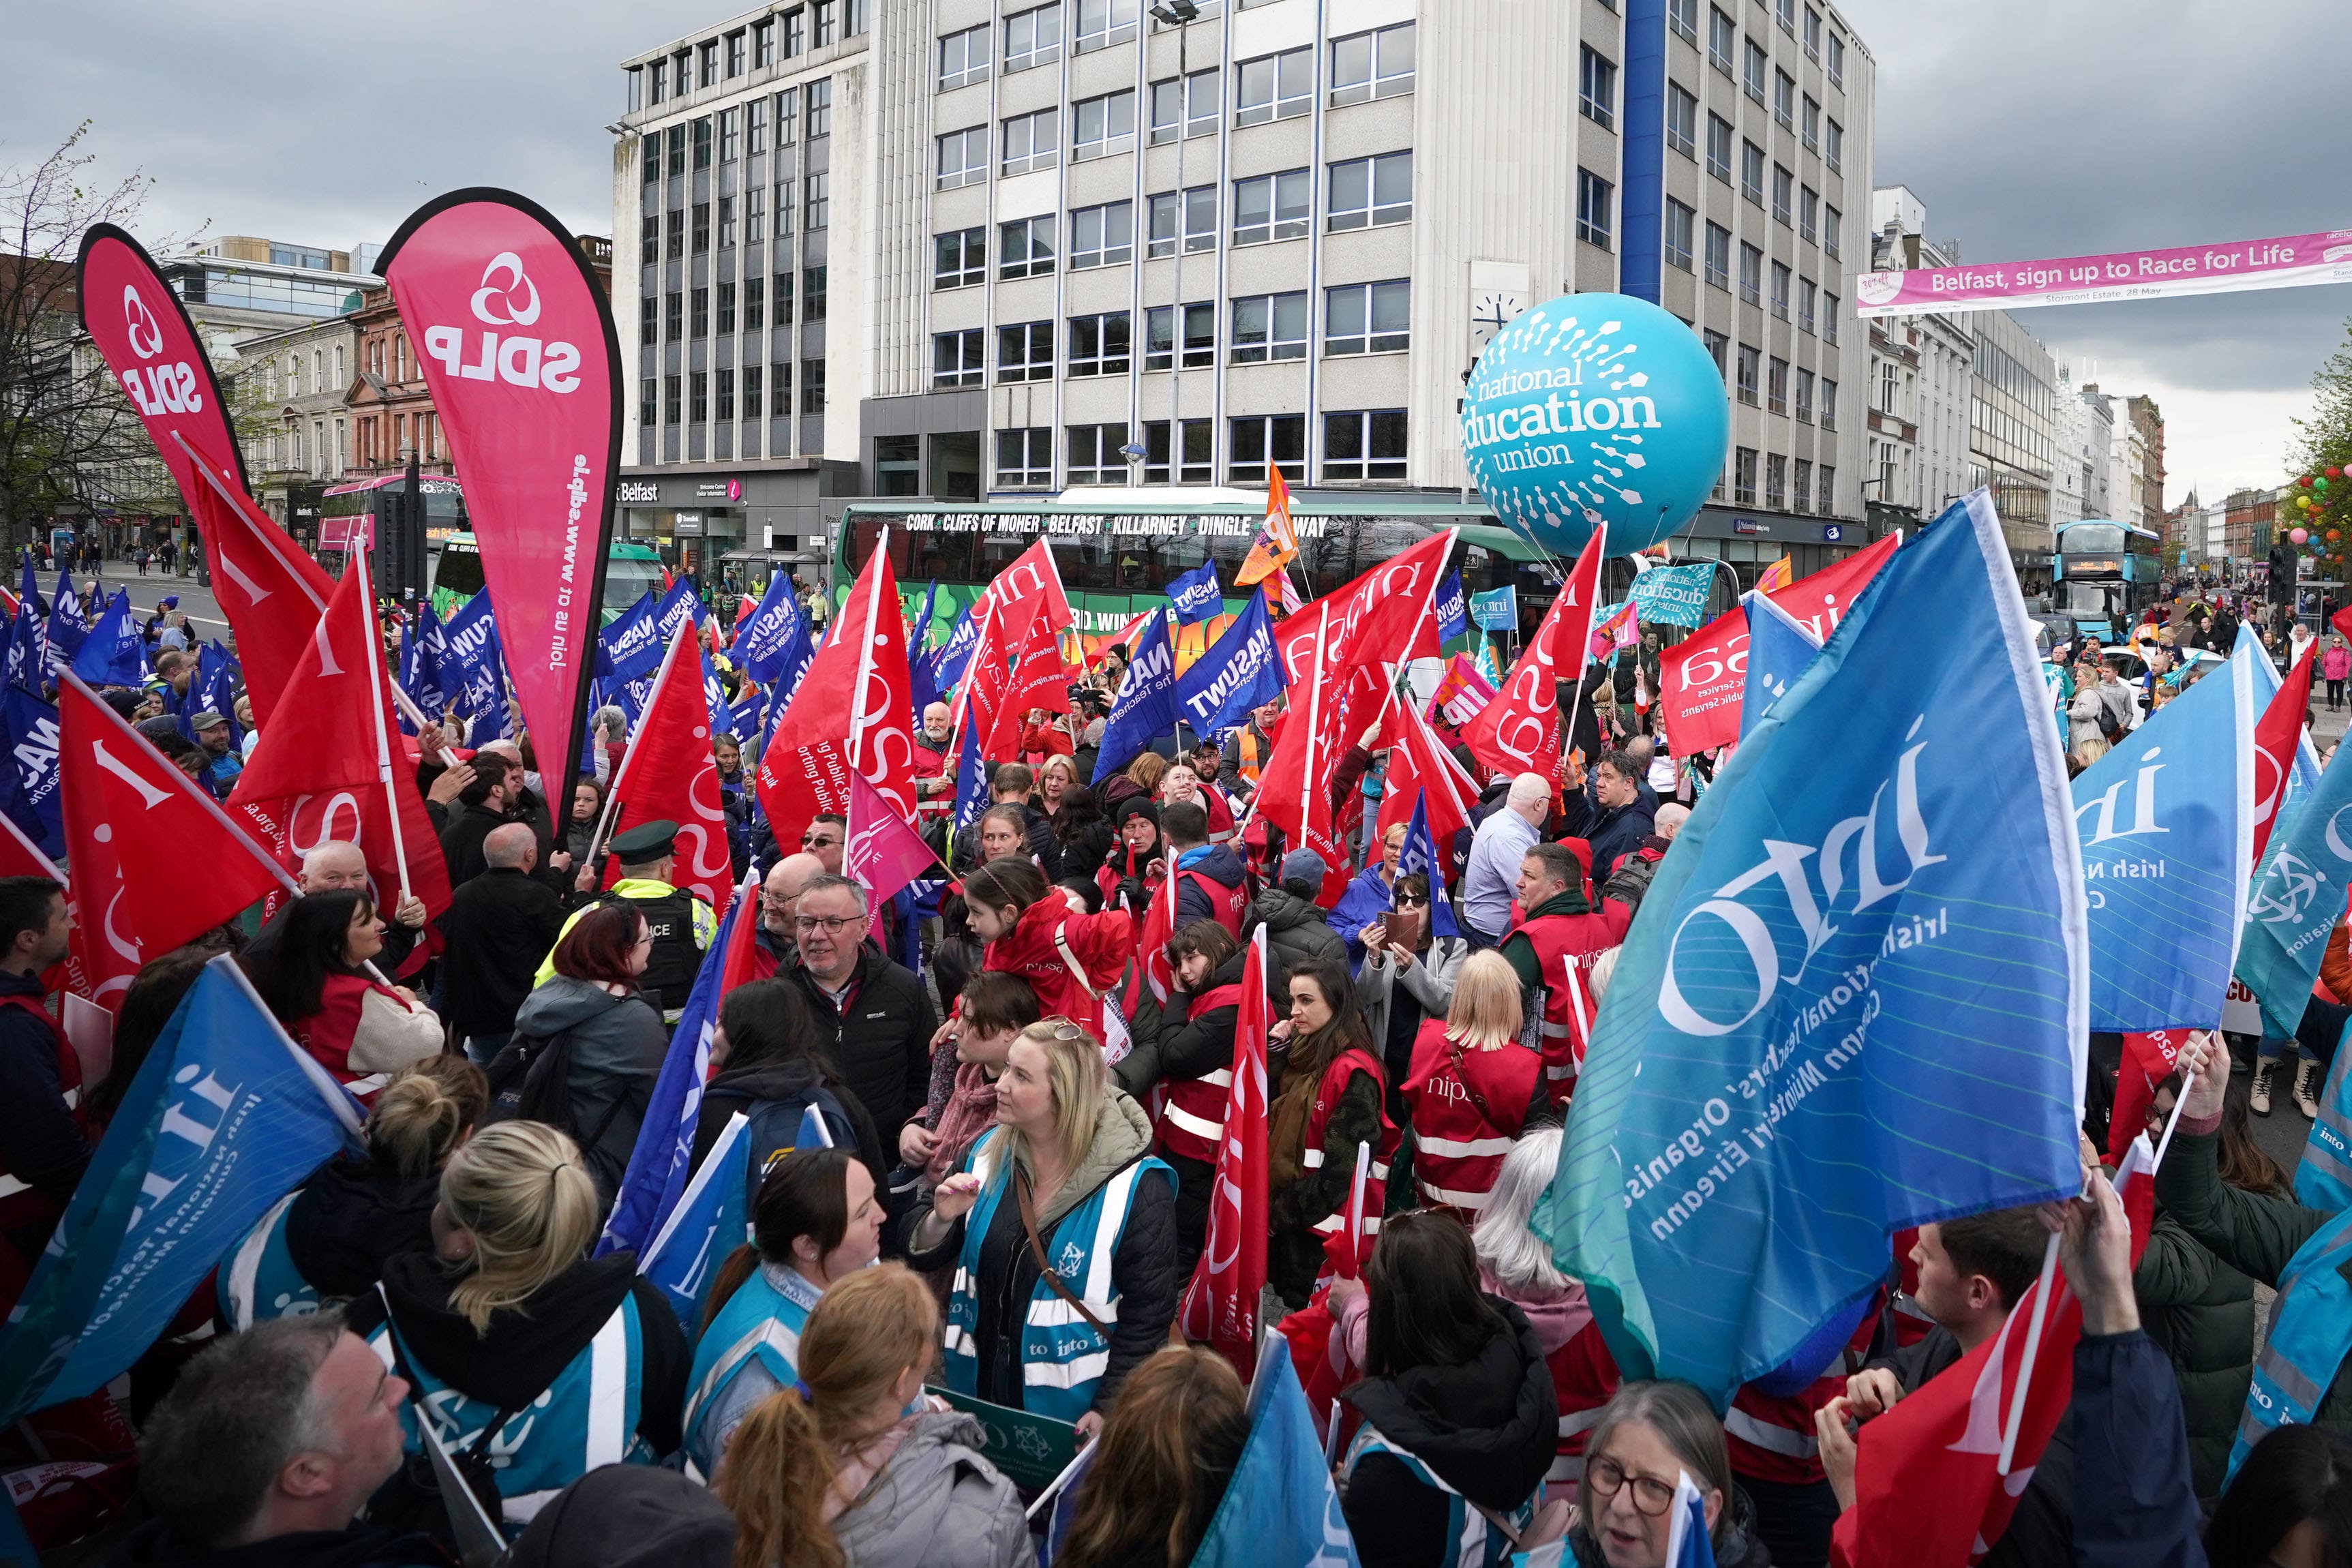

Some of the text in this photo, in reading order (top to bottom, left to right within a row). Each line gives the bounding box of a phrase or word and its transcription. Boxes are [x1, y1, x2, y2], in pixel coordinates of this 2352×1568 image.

[1932, 243, 2295, 292] Belfast, sign up to Race for Life
[2046, 292, 2090, 303] Stormont
[2092, 290, 2124, 301] Estate,
[2140, 287, 2162, 298] May
[1477, 359, 1583, 402] national
[1493, 442, 1574, 473] union
[621, 482, 659, 502] Belfast
[906, 513, 1328, 537] CORK CLIFFS OF MOHER BELFAST KILLARNEY DINGLE WAY
[761, 761, 779, 789] .org.uk
[824, 751, 845, 788] Public
[813, 777, 833, 813] Public
[2226, 981, 2261, 1004] CU
[2319, 1126, 2345, 1151] into
[1029, 1342, 1049, 1356] to
